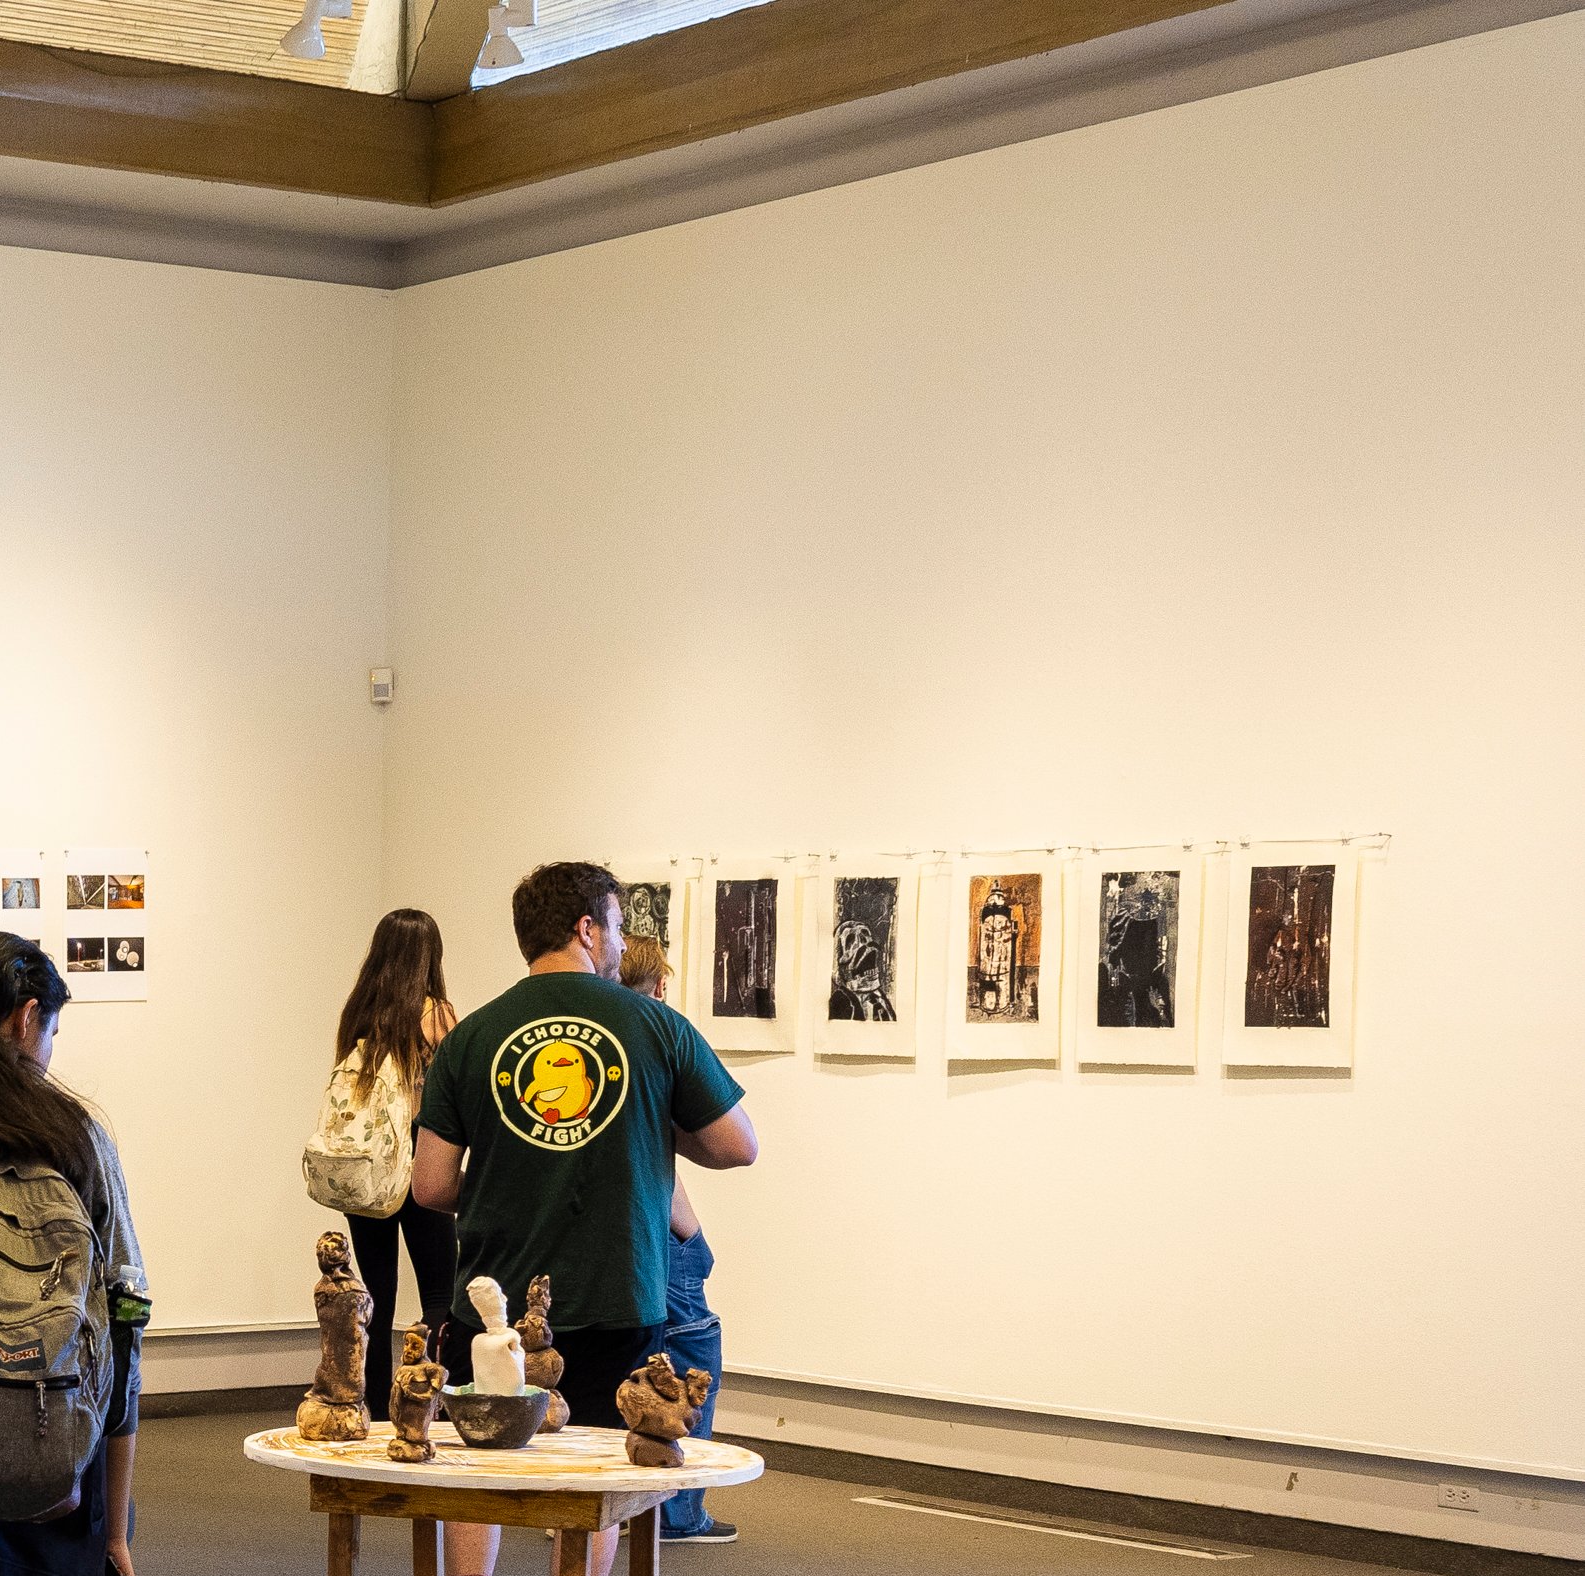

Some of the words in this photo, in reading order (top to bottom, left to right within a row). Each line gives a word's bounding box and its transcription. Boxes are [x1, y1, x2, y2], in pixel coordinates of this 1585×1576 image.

[510, 1044, 523, 1055] I
[522, 1023, 603, 1047] CHOOSE
[530, 1118, 592, 1145] FIGHT
